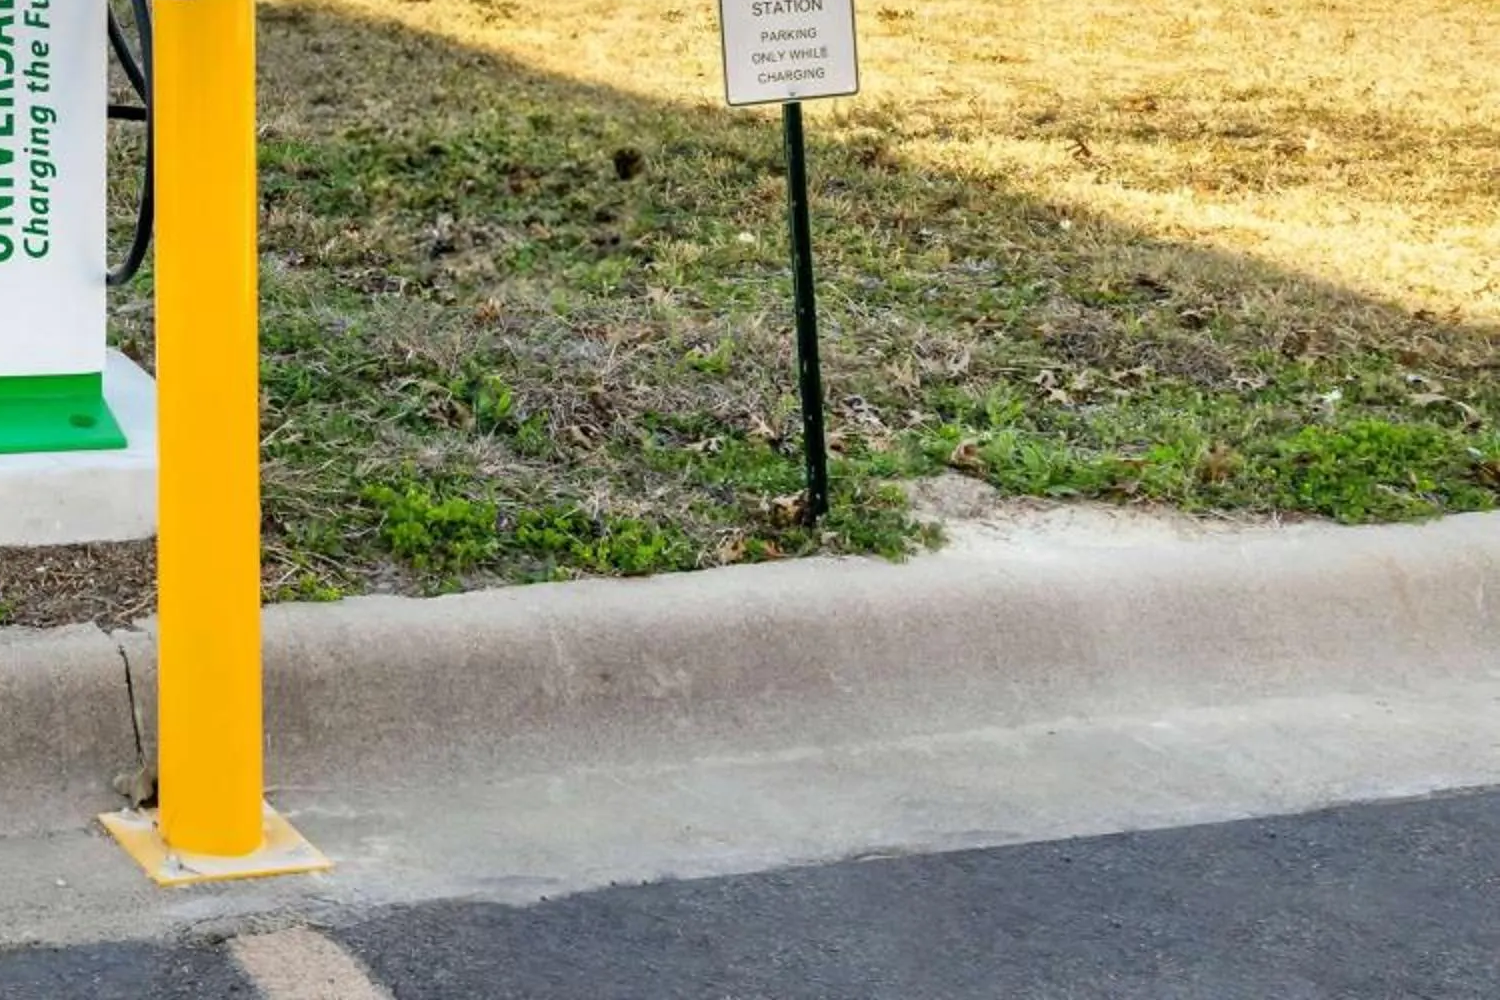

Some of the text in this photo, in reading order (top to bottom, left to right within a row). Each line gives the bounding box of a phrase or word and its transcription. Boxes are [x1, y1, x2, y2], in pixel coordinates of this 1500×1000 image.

[760, 27, 818, 43] PARKING
[751, 47, 829, 65] ONLY WHILE
[23, 40, 50, 93] the
[757, 67, 825, 84] CHARGING
[22, 105, 57, 259] Charging
